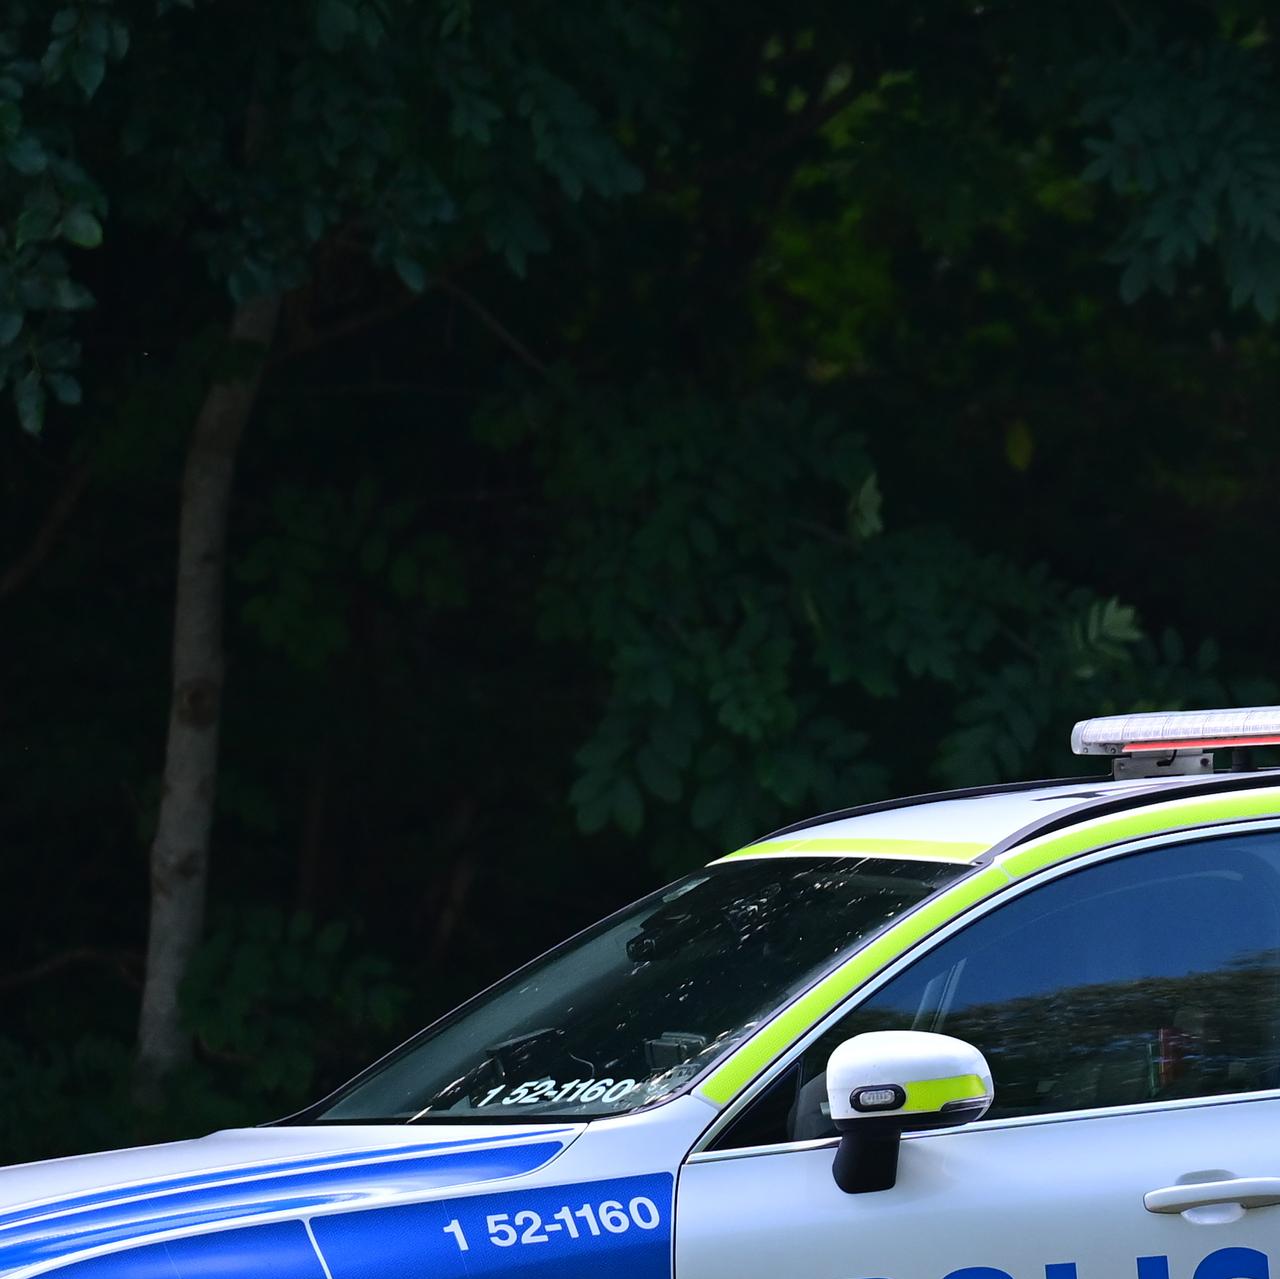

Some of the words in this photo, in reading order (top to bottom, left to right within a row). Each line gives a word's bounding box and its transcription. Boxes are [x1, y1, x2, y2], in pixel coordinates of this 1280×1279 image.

[477, 1084, 506, 1107] 1
[502, 1078, 635, 1105] 52-1160
[443, 1219, 469, 1251] 1
[486, 1197, 660, 1247] 52-1160
